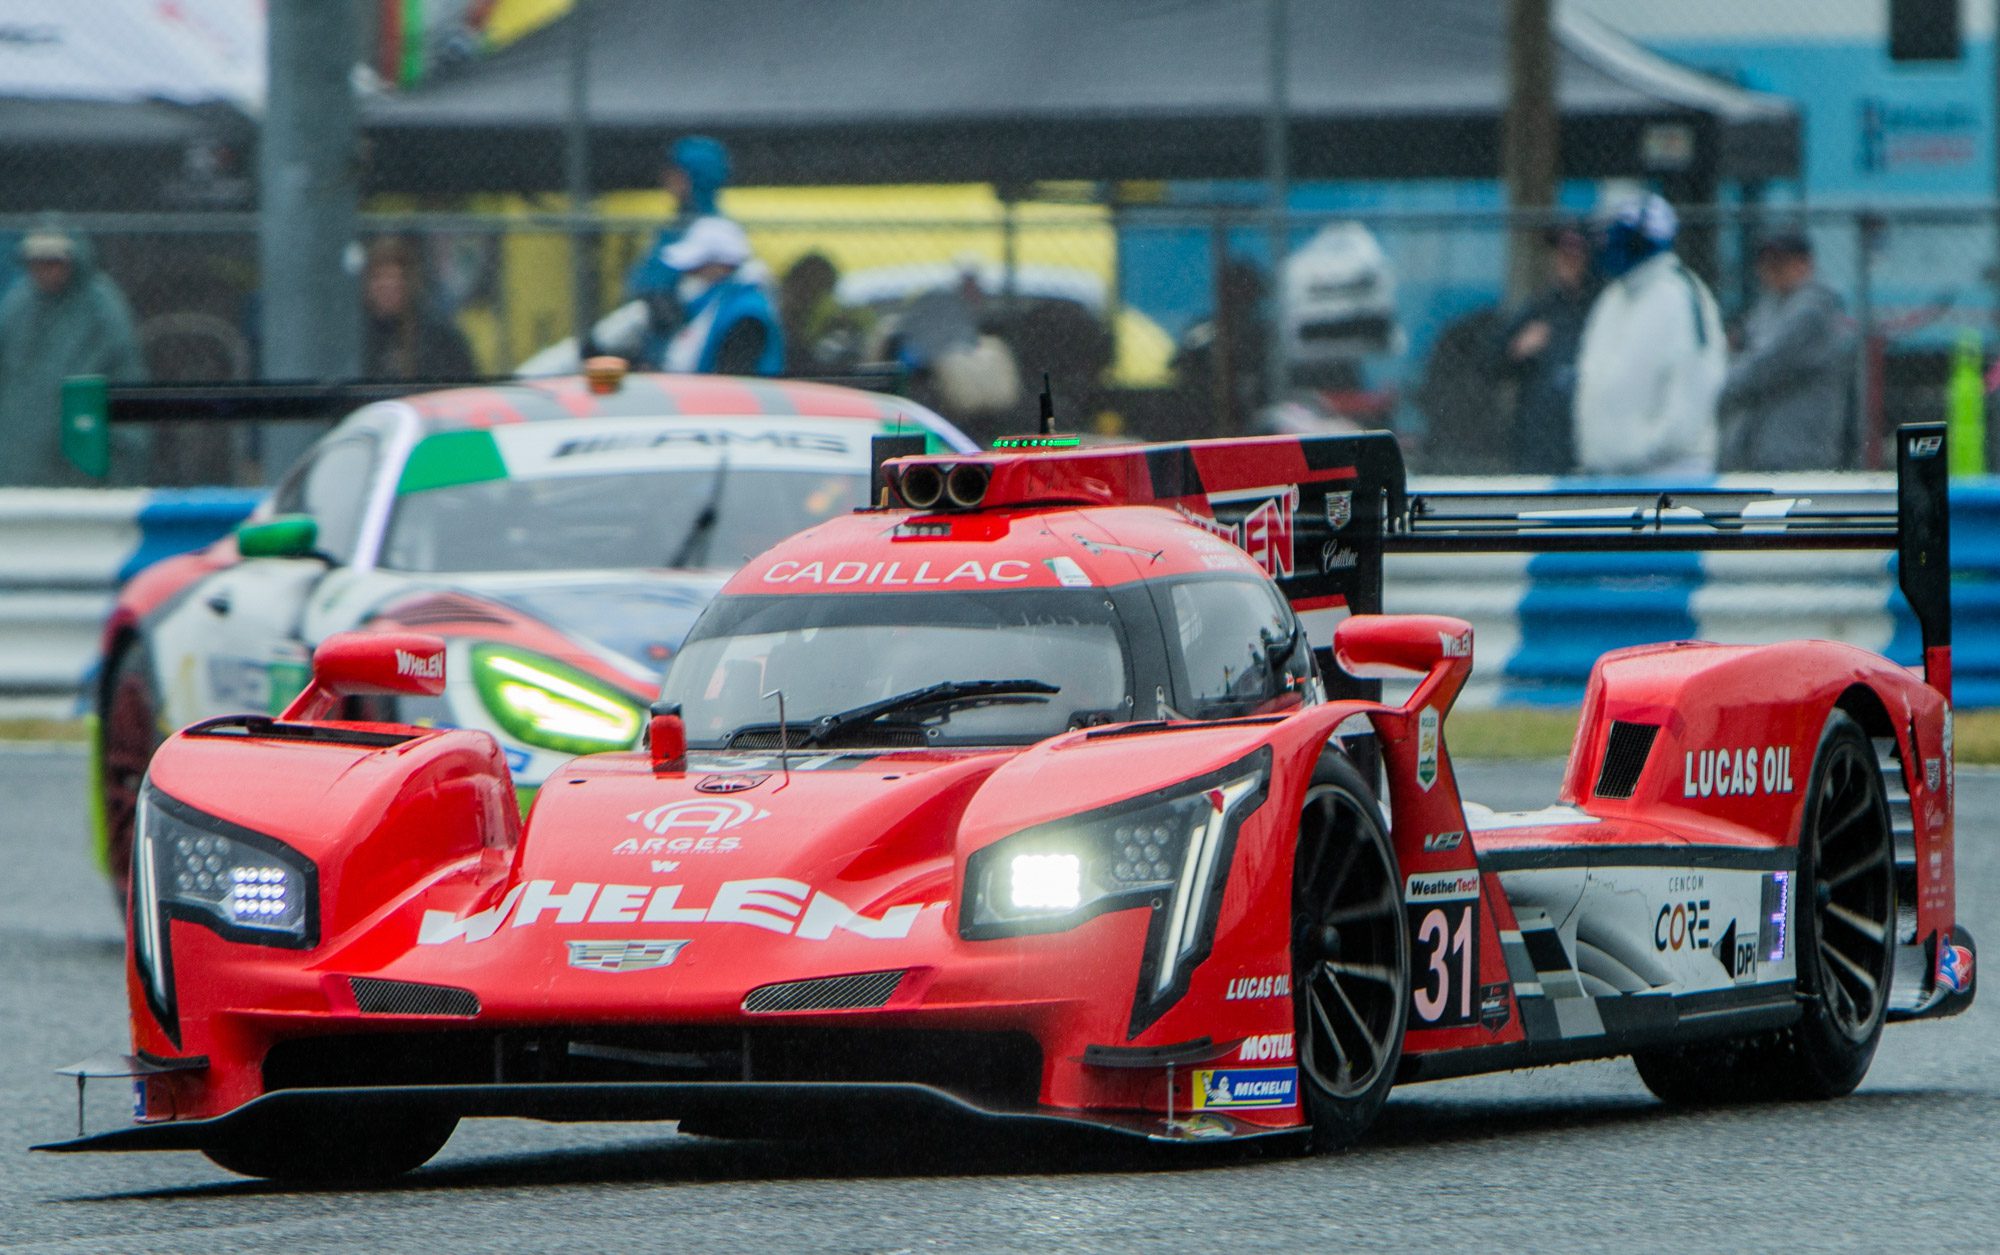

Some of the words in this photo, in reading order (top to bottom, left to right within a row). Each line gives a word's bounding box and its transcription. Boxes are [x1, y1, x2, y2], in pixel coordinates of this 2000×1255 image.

[654, 429, 849, 452] AMG
[763, 560, 1030, 584] CADILLAC
[395, 648, 444, 677] WHELEN
[1684, 748, 1758, 798] LUCAS
[1762, 746, 1793, 793] OIL
[612, 836, 742, 852] ARGES
[1411, 878, 1477, 895] WeatherTech
[1668, 875, 1704, 893] CENCOM
[417, 878, 923, 943] WHELEN
[1655, 900, 1710, 951] CORE
[1414, 906, 1472, 1021] 31
[1737, 943, 1756, 976] DPi
[1226, 975, 1273, 1000] LUCAS
[1274, 974, 1291, 996] OIL
[1239, 1033, 1293, 1061] MOTUL
[1234, 1080, 1292, 1096] MICHELIN
